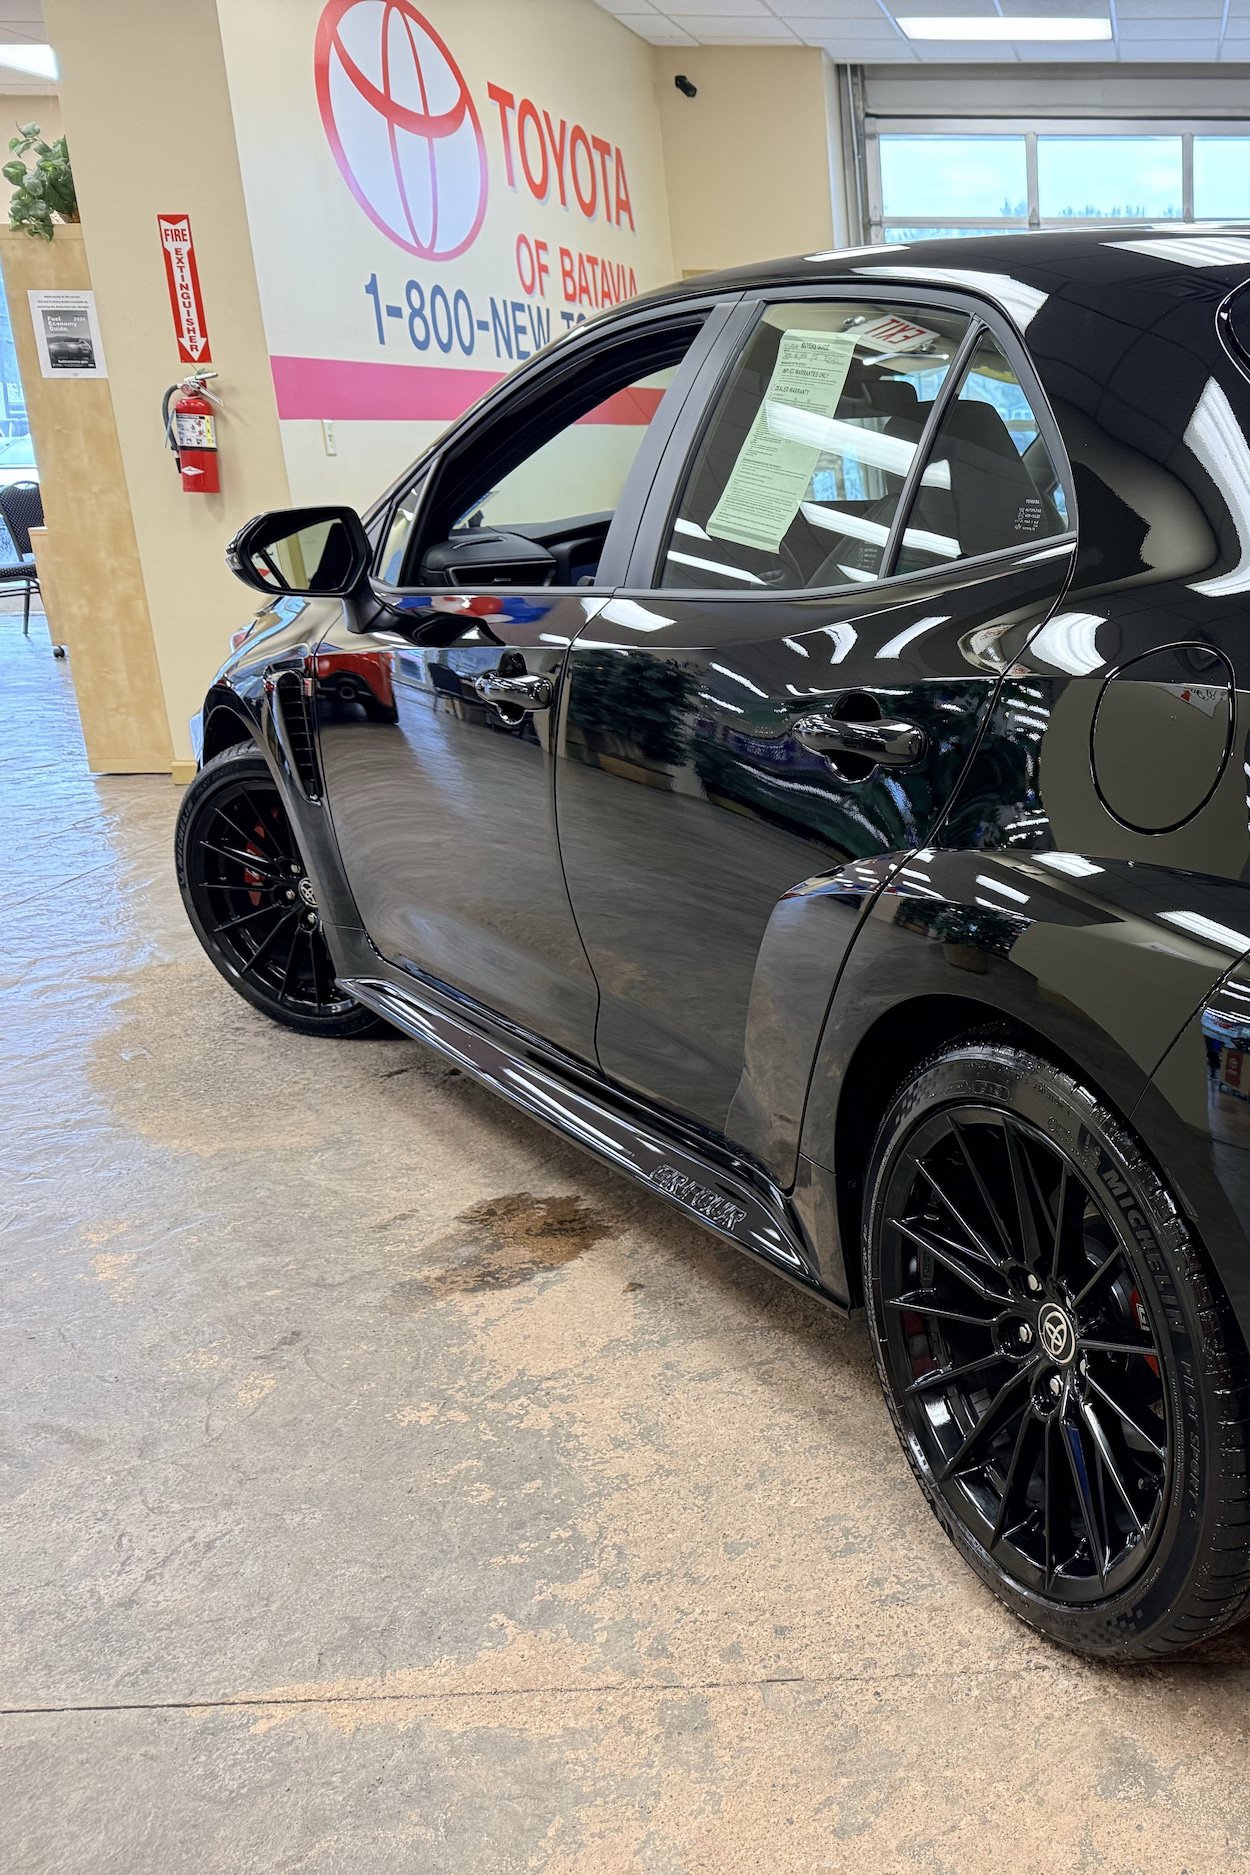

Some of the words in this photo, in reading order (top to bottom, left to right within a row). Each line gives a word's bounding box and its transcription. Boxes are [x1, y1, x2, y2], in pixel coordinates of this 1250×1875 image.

[487, 81, 636, 233] TOYOTA
[163, 228, 188, 242] FIRE
[516, 233, 549, 297] OF
[174, 248, 199, 352] EXTINGUISHER
[364, 272, 550, 360] 1-800-NEW
[1102, 1168, 1186, 1334] MICHELIN
